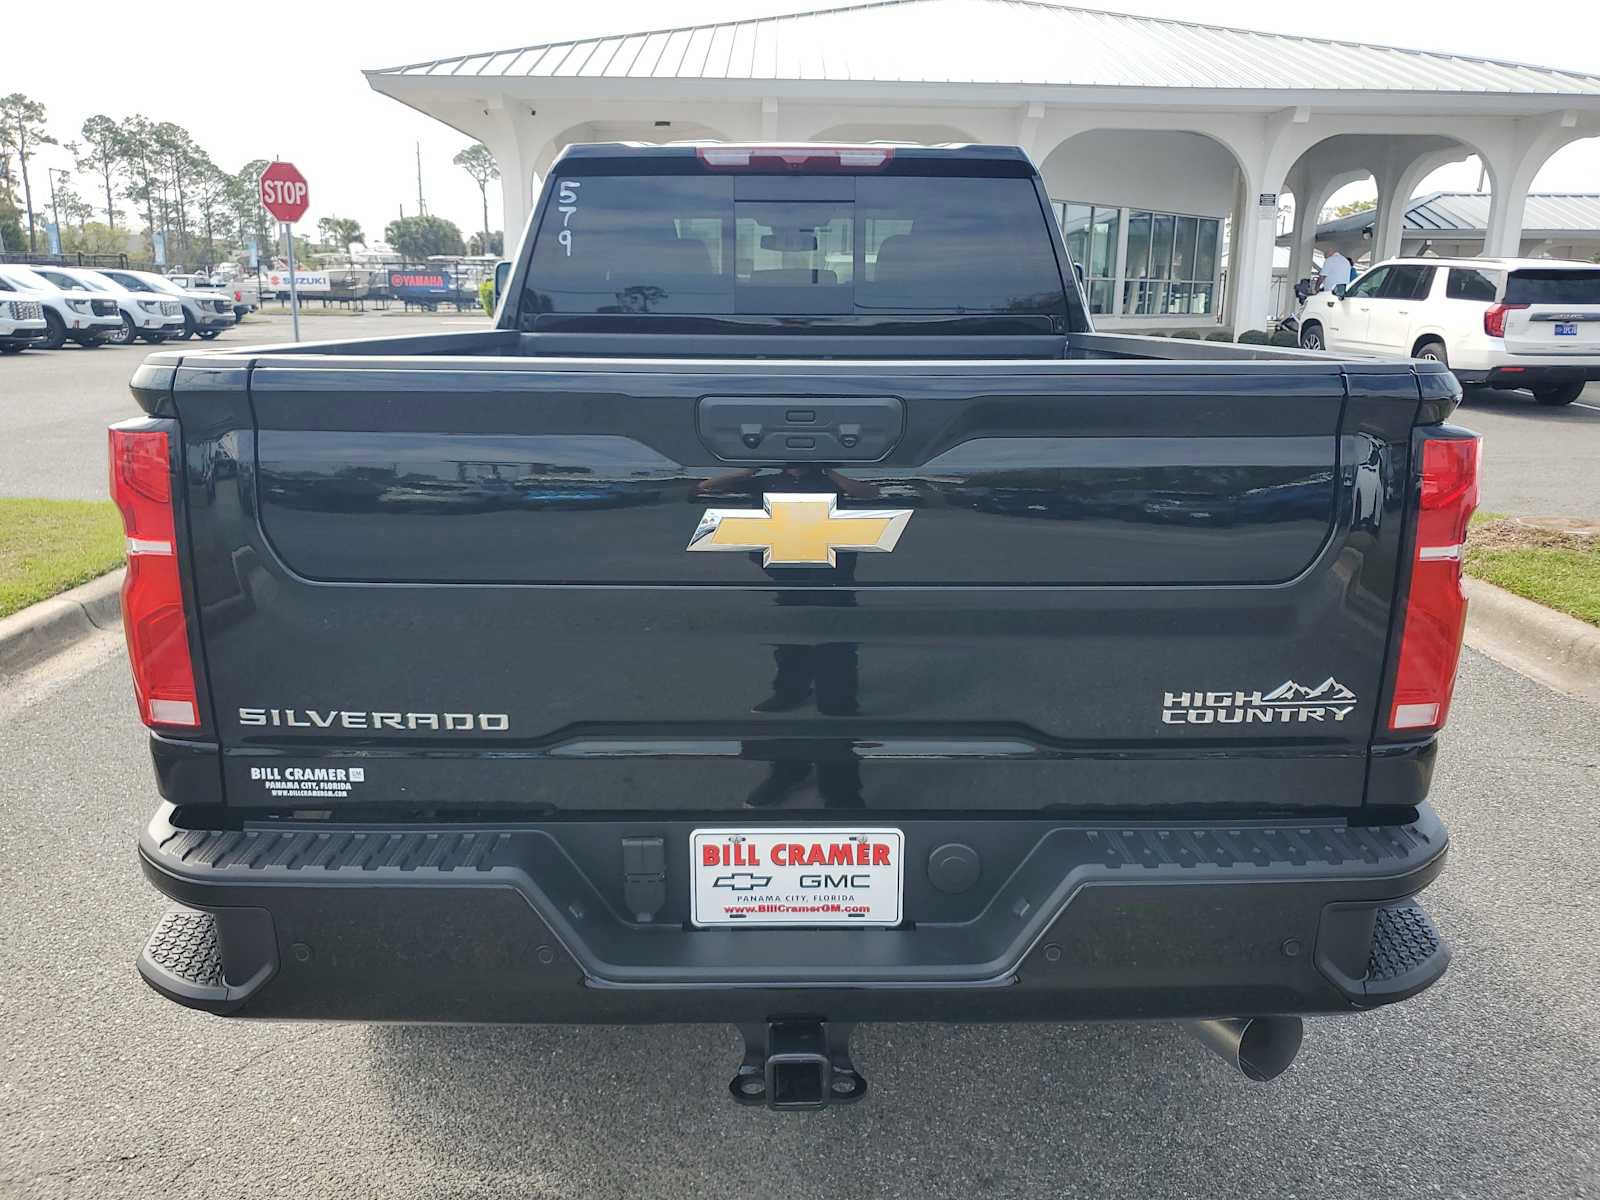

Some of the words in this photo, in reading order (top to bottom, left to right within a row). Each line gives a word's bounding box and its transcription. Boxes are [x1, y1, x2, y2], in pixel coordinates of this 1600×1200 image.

[264, 180, 306, 205] STOP
[558, 181, 581, 257] 579
[403, 275, 443, 287] YAMAHA
[1163, 691, 1262, 707] HIGH
[239, 707, 509, 730] SILVERADO
[1162, 706, 1354, 724] COUNTRY
[250, 767, 282, 780] BILL
[285, 767, 347, 781] CRAMER
[265, 781, 299, 790] PANAMA
[300, 781, 319, 790] CITY,
[320, 782, 352, 790] FLORIDA
[702, 843, 760, 867] BILL
[770, 843, 891, 867] CRAMER
[800, 874, 870, 889] GMC
[785, 895, 809, 903] CITY,
[724, 904, 871, 914] www.BillCramerGM.com
